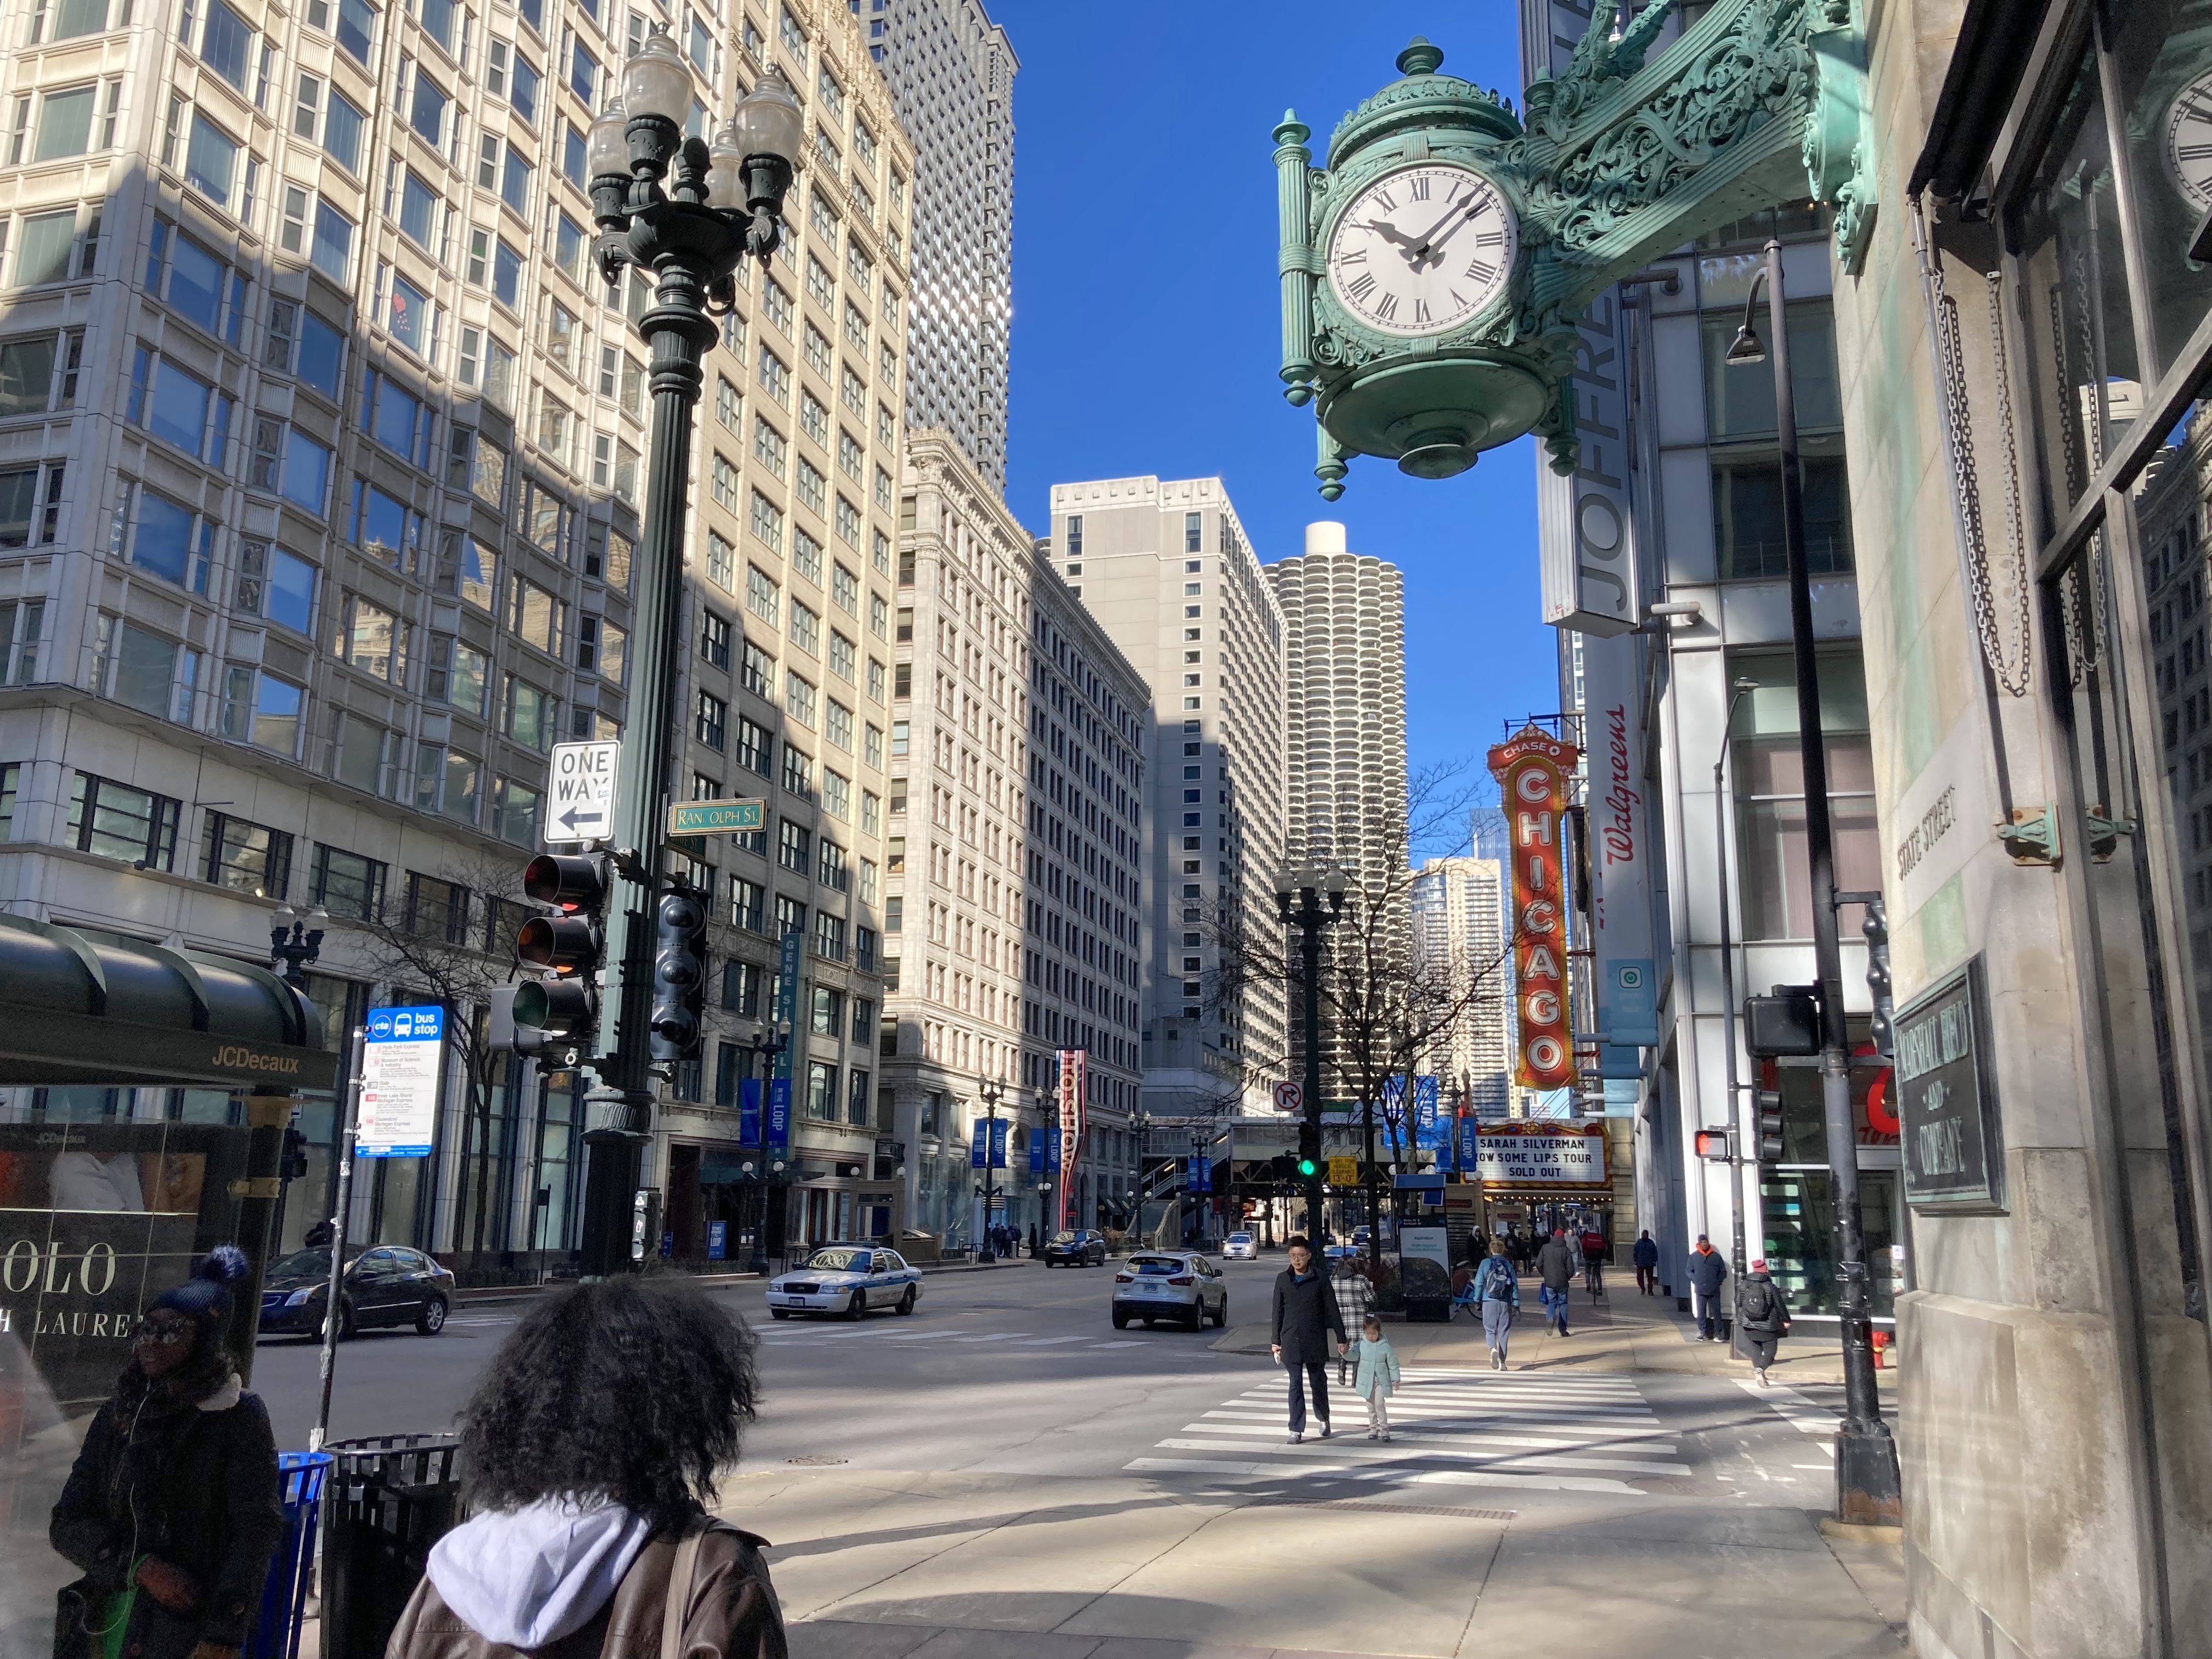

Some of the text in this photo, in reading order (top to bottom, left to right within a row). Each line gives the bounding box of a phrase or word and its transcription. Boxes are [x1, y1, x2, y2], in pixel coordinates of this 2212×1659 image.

[1408, 177, 1431, 202] XII
[1372, 189, 1399, 217] XI
[1475, 230, 1503, 249] III
[1576, 297, 1628, 612] JOFFRE
[1503, 741, 1548, 759] CHASE
[561, 750, 609, 775] ONE
[1603, 704, 1640, 866] Walgreens
[679, 810, 740, 826] RANOLPH
[1897, 783, 1956, 882] STATE STREET
[1516, 769, 1564, 1072] CHICAGO
[785, 940, 794, 986] GENE
[375, 1022, 390, 1030] cta
[415, 1013, 435, 1024] bus
[414, 1025, 438, 1037] stop
[212, 1045, 300, 1074] JCDecaux
[772, 1105, 785, 1131] LOOP
[36, 1133, 86, 1144] JCDecaux
[994, 1135, 1004, 1154] LOOP
[1059, 1098, 1076, 1172] SHOW
[1480, 1139, 1585, 1149] SARAH SILVERMAN
[1920, 1116, 1965, 1176] COMPANY
[1050, 1145, 1059, 1163] LOOP
[1462, 1138, 1472, 1159] LOOP
[1498, 1153, 1527, 1163] SOME
[1534, 1153, 1559, 1163] LIPS
[1564, 1154, 1592, 1164] TOUR
[1509, 1167, 1561, 1177] SOLD OUT
[33, 1310, 144, 1338] LAURE
